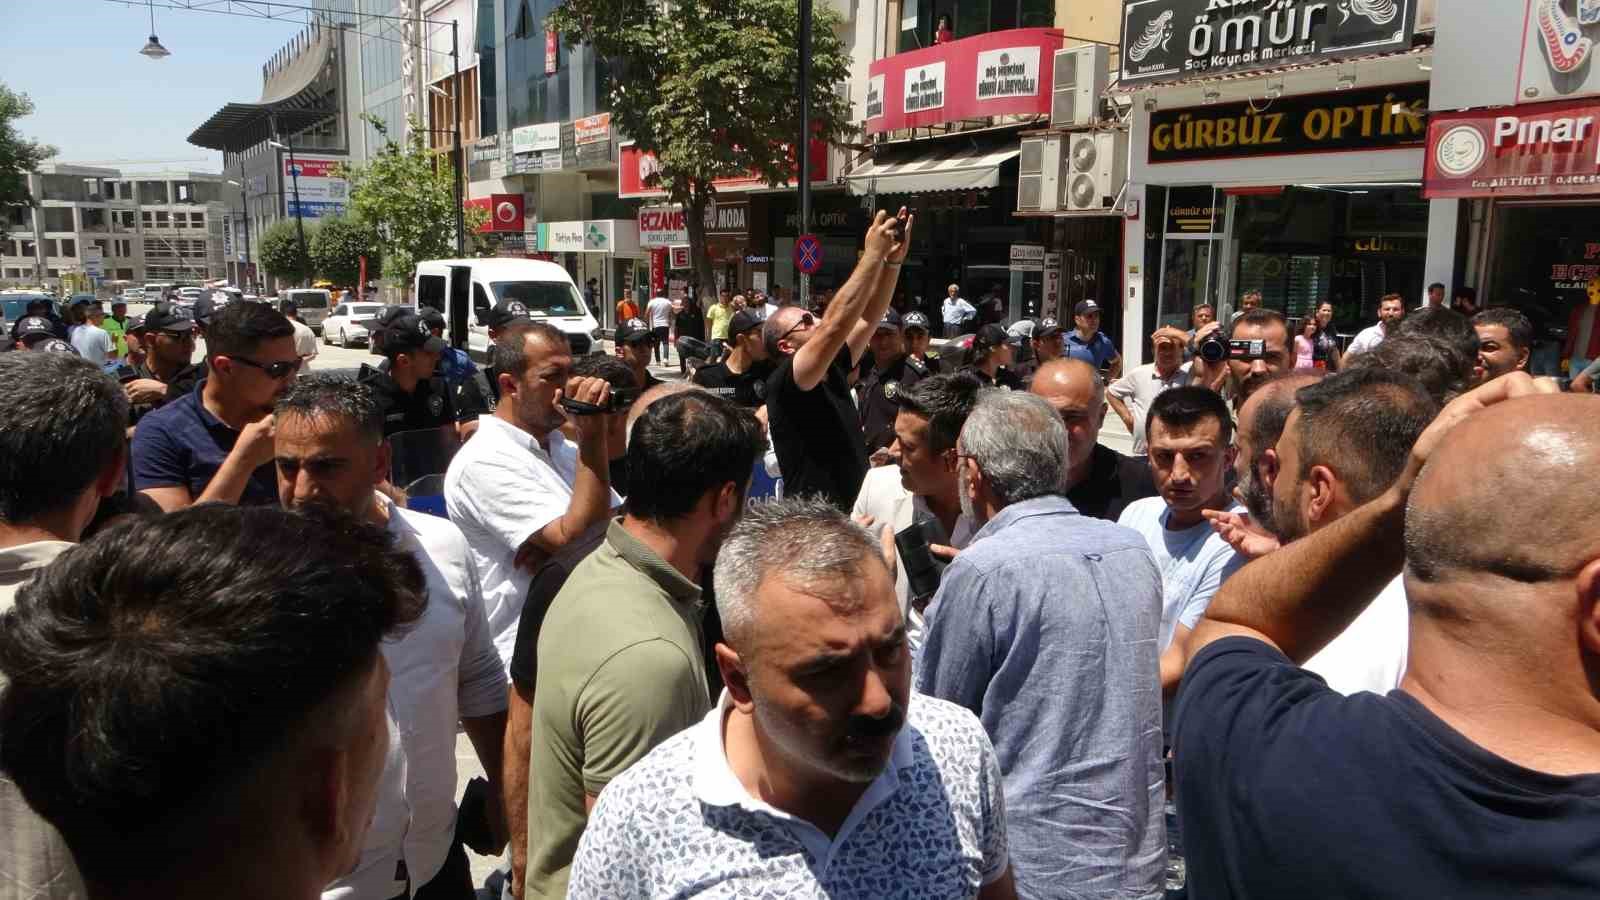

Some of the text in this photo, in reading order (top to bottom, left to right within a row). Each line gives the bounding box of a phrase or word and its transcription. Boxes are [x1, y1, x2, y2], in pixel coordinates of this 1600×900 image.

[1185, 41, 1315, 71] Saç Kaynak Merkezi
[1152, 93, 1424, 150] GÜRBÜZ OPTİK
[1494, 116, 1593, 147] Pınar
[641, 211, 686, 231] ECZANE
[718, 207, 745, 229] MODA
[676, 251, 687, 266] E
